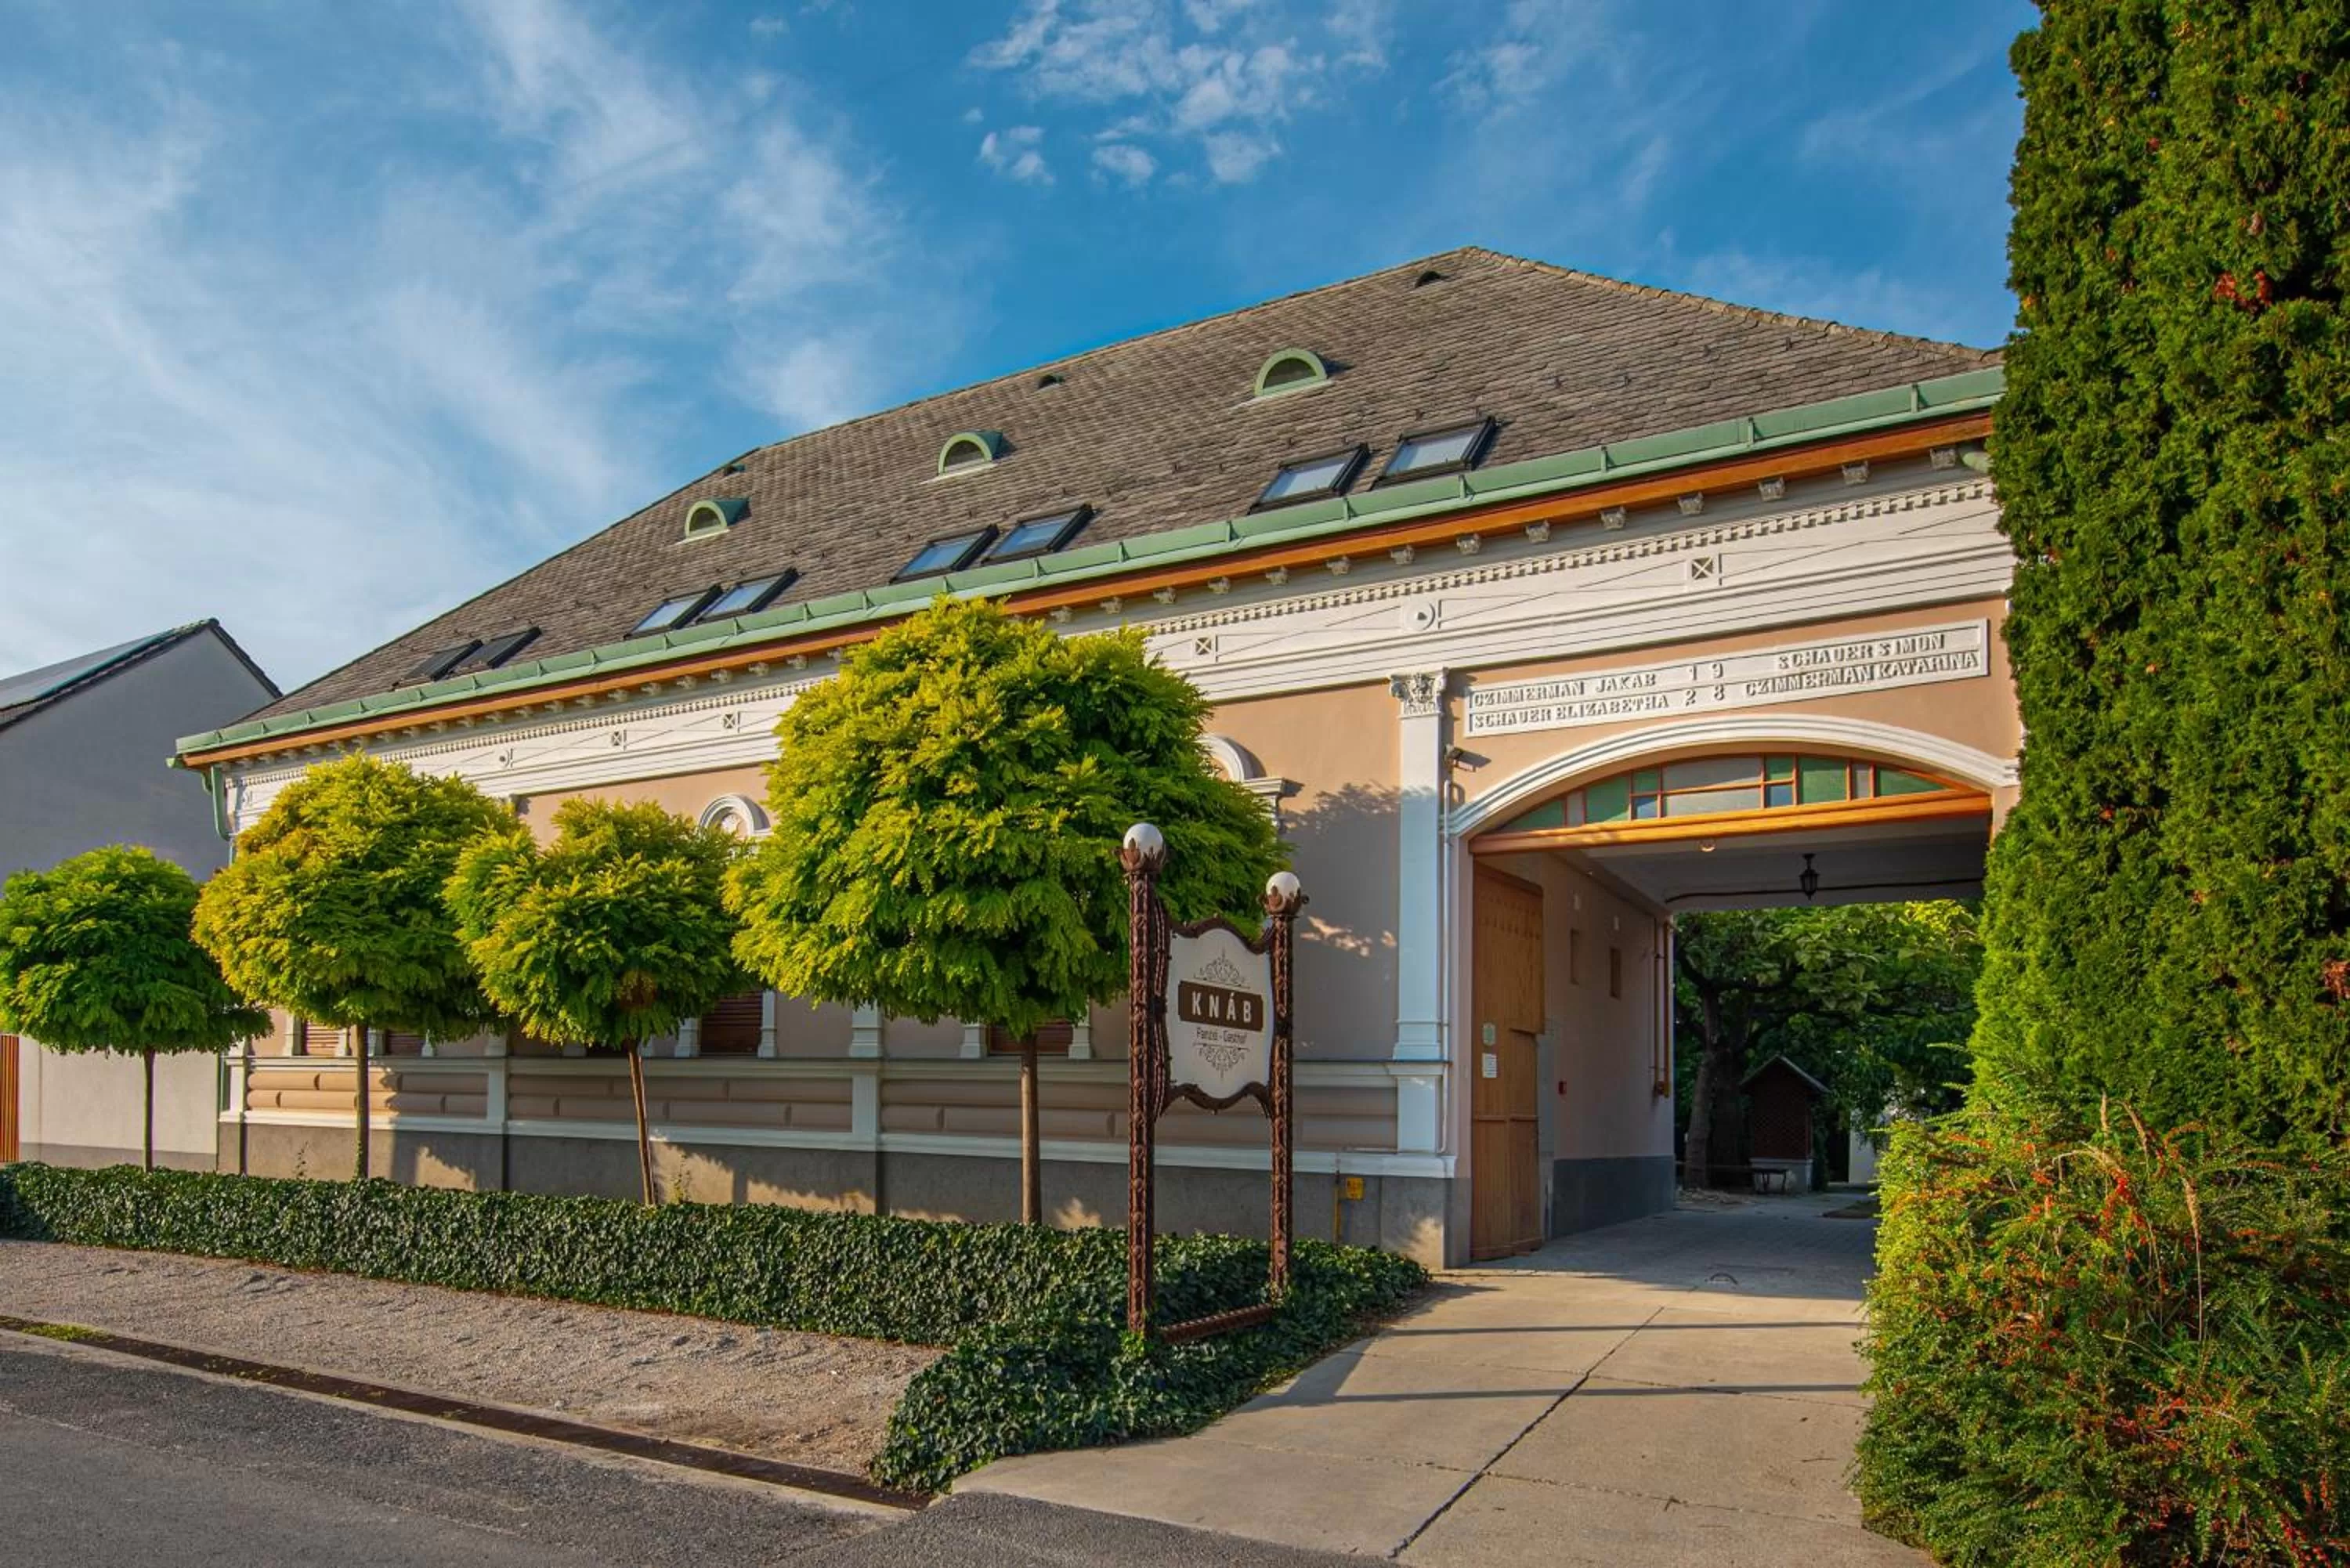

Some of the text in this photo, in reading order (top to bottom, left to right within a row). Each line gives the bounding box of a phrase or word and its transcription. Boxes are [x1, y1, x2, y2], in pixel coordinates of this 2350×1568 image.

[1474, 681, 1585, 706] CZIMMERMAN
[1595, 673, 1656, 693] JAKAB
[1779, 644, 1873, 670] SCHAUER
[1474, 707, 1552, 728] SCHAUER
[1556, 695, 1669, 720] ELIZABETHA
[1746, 663, 1875, 696] CZIMMERMAN
[1878, 652, 1979, 679] KATARINA
[1192, 992, 1252, 1023] KNÁB
